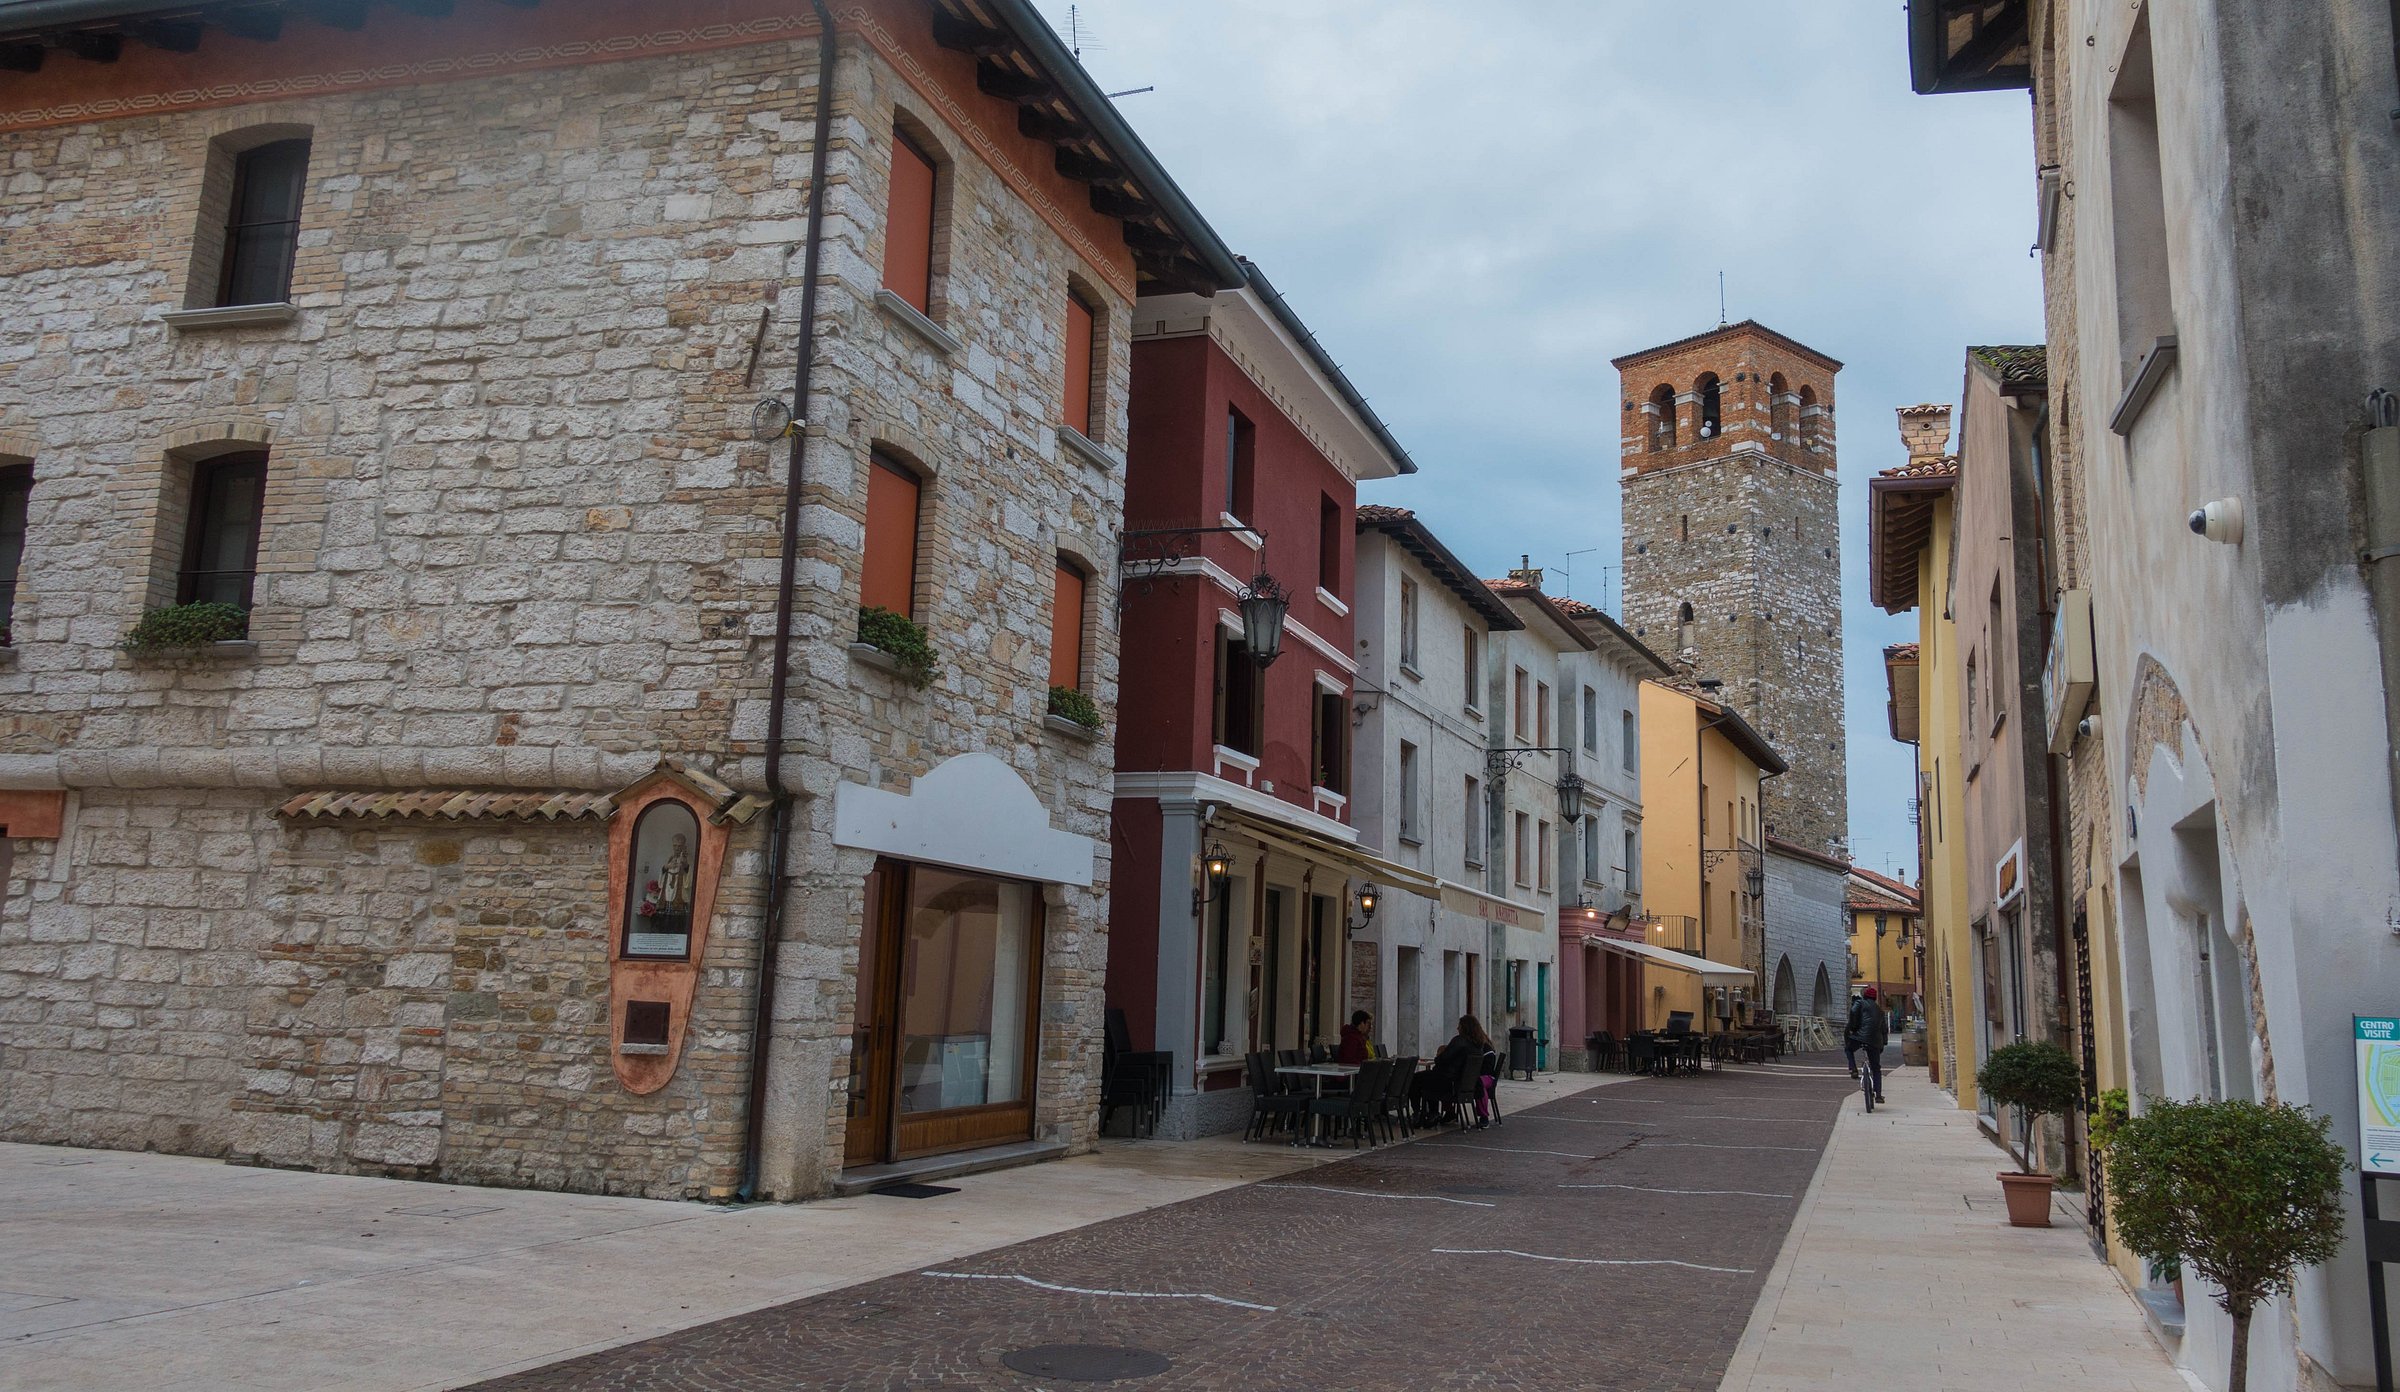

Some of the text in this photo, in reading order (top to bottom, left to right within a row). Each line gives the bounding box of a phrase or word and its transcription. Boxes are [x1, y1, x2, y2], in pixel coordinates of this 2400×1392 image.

[1478, 900, 1488, 917] BAR
[2360, 1020, 2395, 1030] CENTRO
[2363, 1029, 2391, 1039] VISITE
